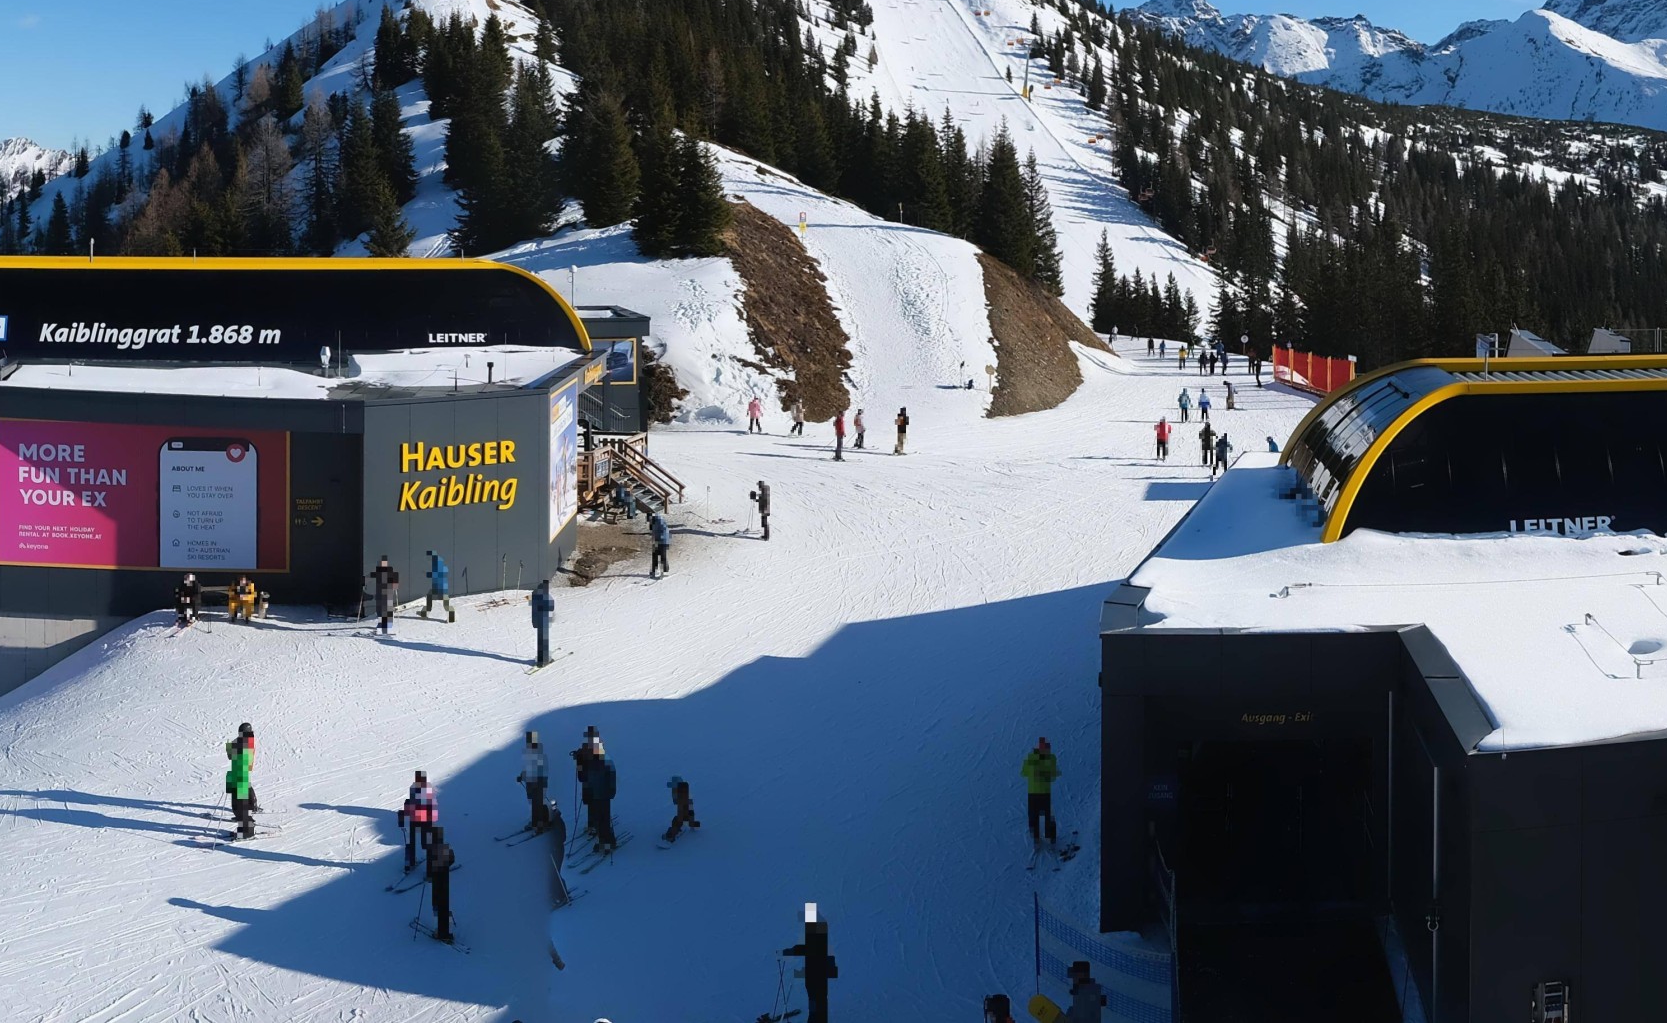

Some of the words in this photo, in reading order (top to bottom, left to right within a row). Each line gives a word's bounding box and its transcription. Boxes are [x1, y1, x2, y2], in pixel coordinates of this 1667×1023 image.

[39, 323, 181, 350] Kaiblinggrat
[186, 325, 253, 344] 1.868
[258, 329, 282, 344] m
[428, 332, 487, 344] LEITNER
[18, 443, 85, 462] MORE
[401, 439, 516, 473] HAUSER
[18, 466, 60, 484] FUN
[67, 468, 127, 486] THAN
[20, 489, 76, 507] YOUR
[81, 491, 107, 507] EX
[398, 472, 518, 512] Kaibling
[1510, 515, 1613, 537] LEITNER
[1241, 712, 1287, 725] Ausgang
[1153, 784, 1168, 792] KEIN
